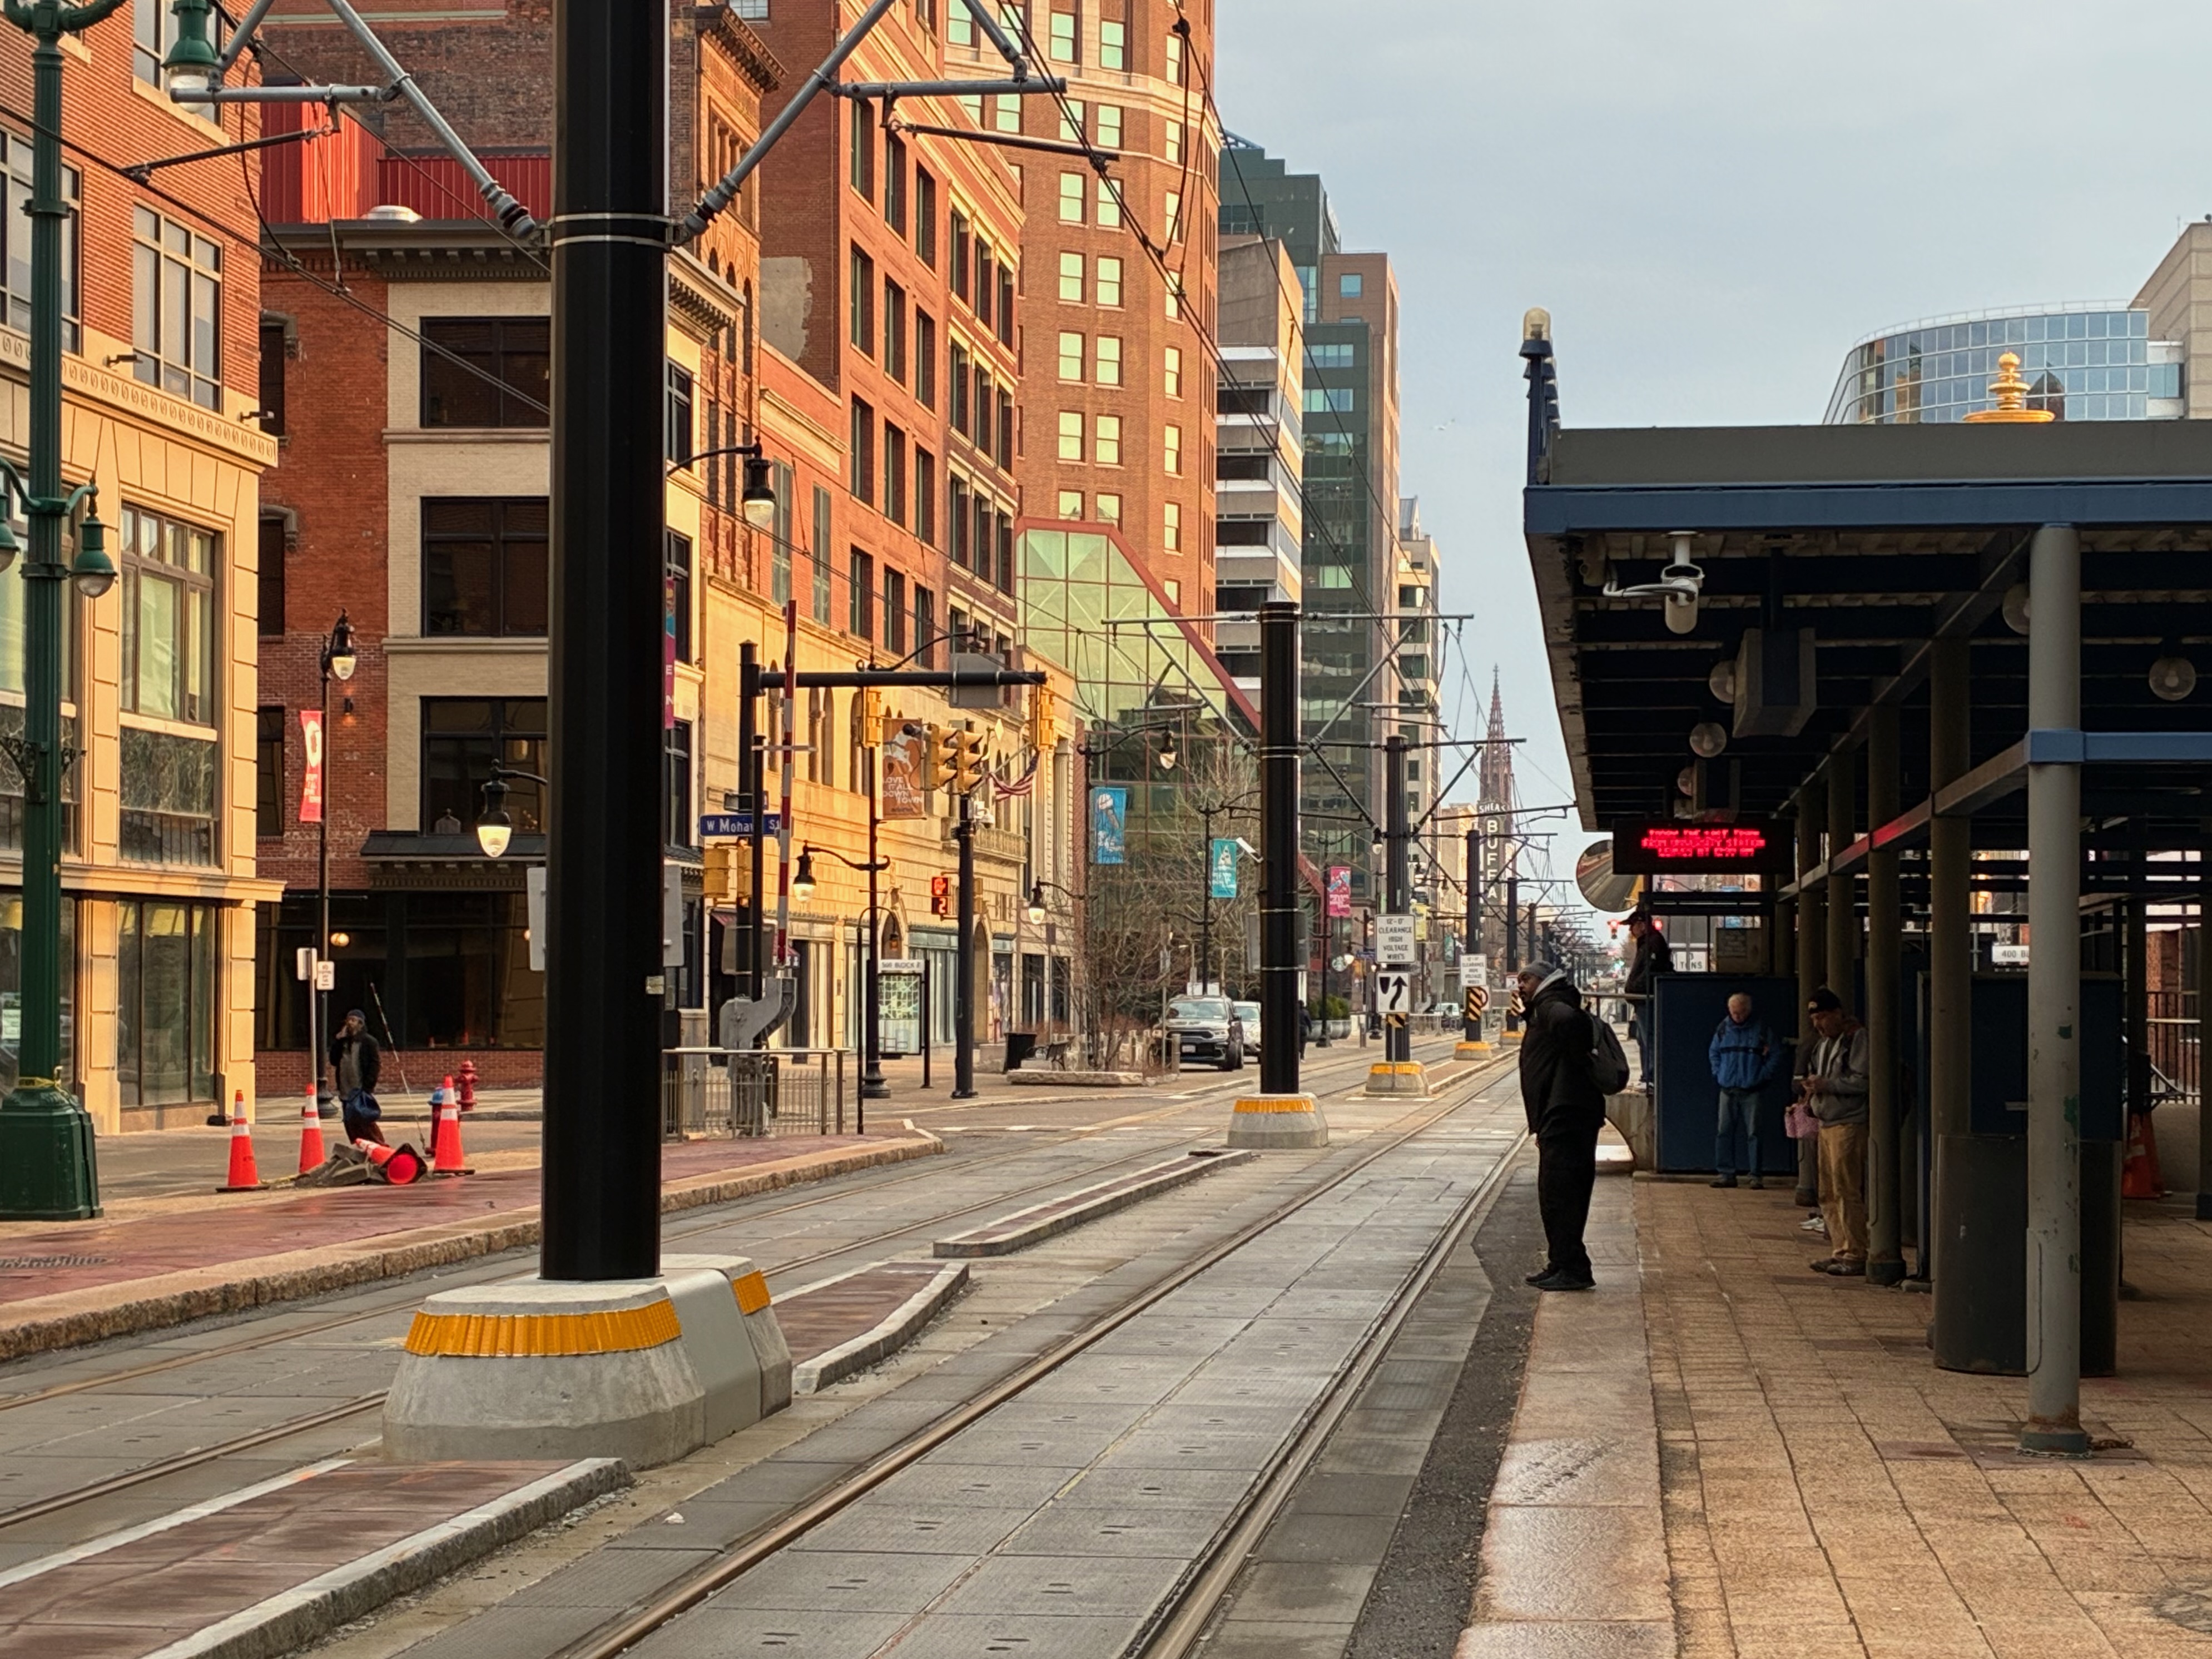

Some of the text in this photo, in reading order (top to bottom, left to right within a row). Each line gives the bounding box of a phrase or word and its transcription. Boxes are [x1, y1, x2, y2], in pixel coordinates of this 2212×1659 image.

[707, 820, 715, 831] W
[719, 818, 753, 833] Moha
[939, 897, 946, 913] 2
[2001, 950, 2017, 958] 400
